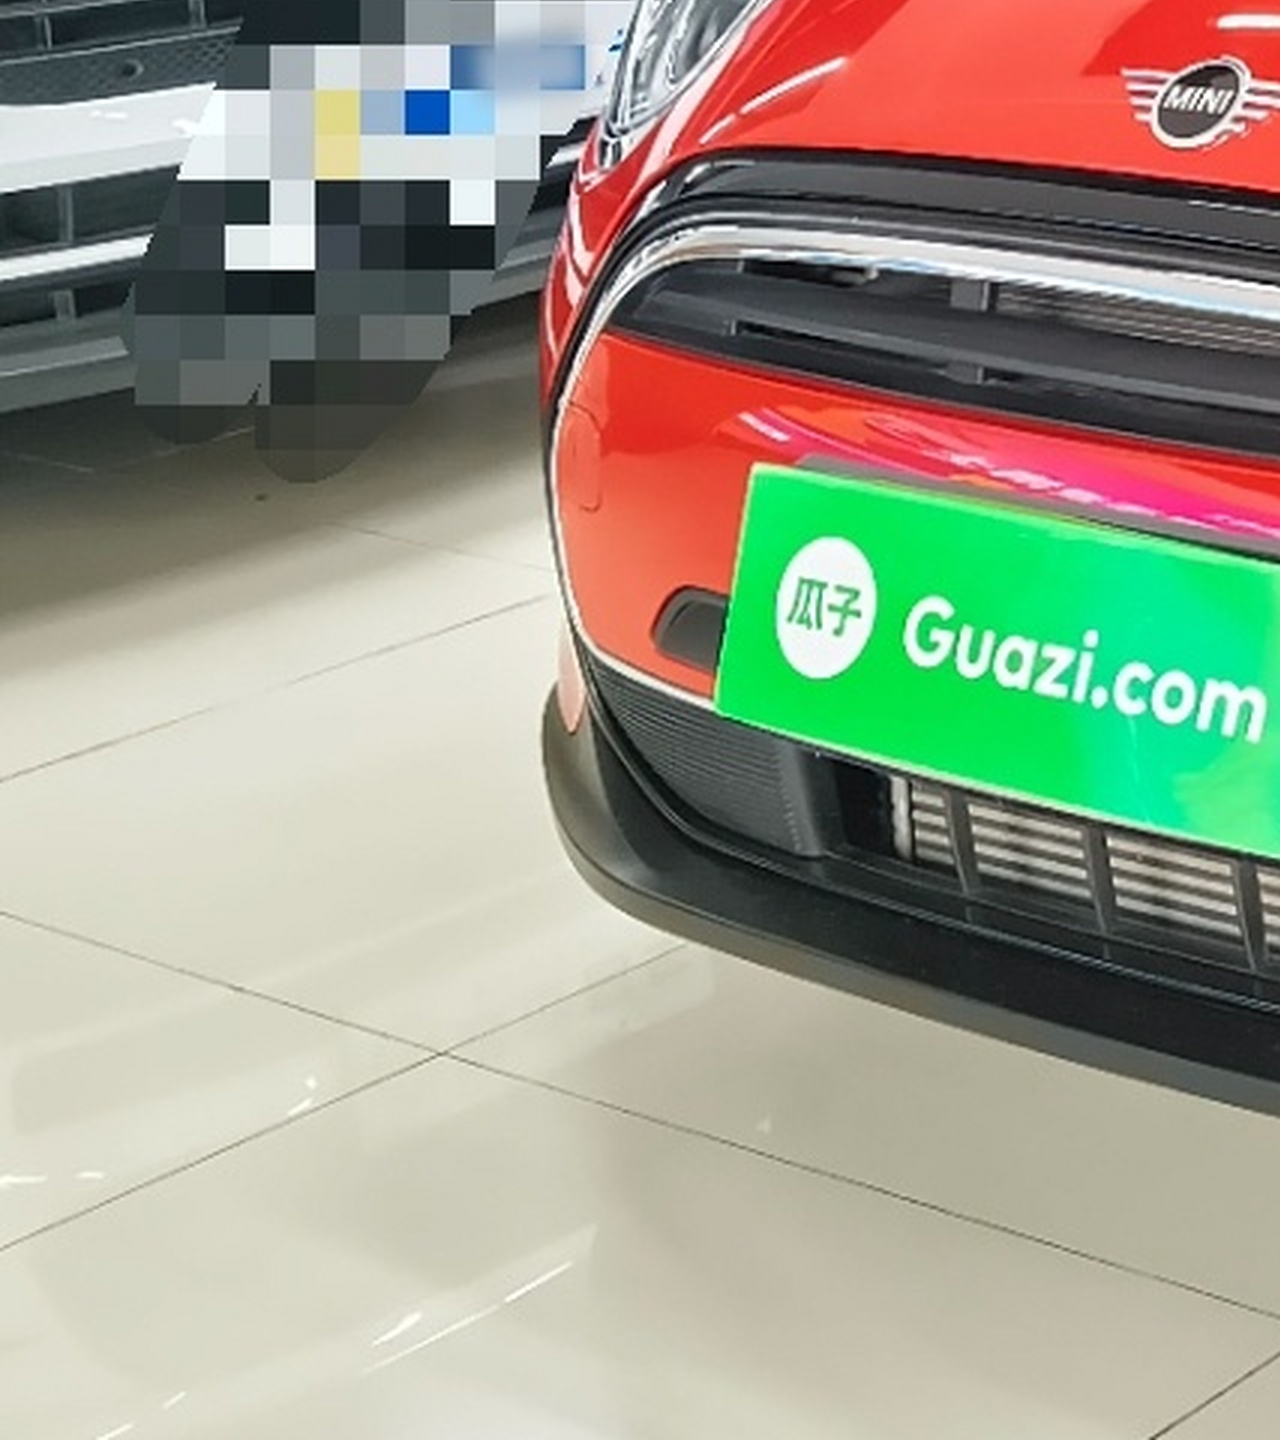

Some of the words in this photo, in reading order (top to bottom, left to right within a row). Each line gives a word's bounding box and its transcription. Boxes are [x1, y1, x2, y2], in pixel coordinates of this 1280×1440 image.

[1163, 84, 1234, 115] MINI
[786, 577, 862, 637] 瓜子
[903, 594, 1267, 743] Guazi.com
